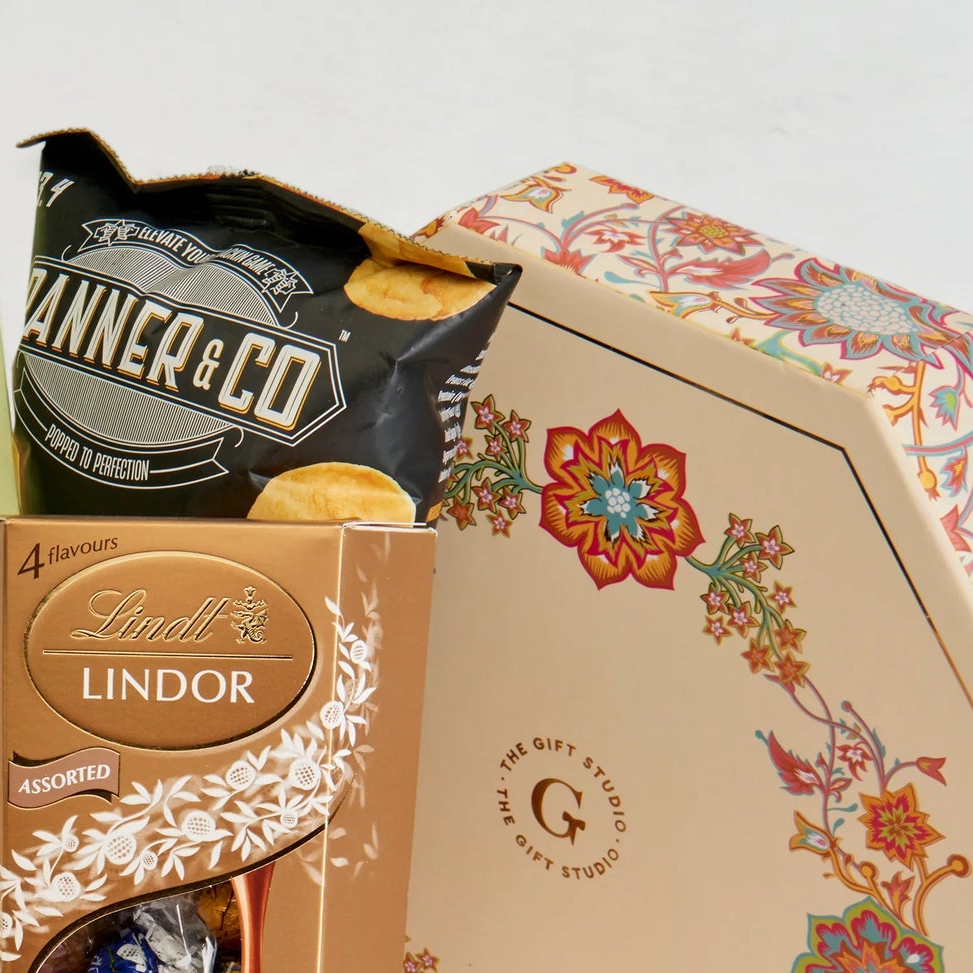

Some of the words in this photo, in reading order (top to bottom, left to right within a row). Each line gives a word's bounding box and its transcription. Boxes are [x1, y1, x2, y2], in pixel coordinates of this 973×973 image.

[138, 227, 187, 252] ELEVATE
[193, 338, 224, 390] &
[218, 331, 322, 431] CO
[45, 423, 80, 462] POPPED
[79, 446, 93, 469] TO
[93, 452, 150, 481] PERFECTION
[17, 542, 45, 580] 4
[47, 536, 120, 565] flavours
[69, 588, 231, 643] Lindt
[82, 667, 256, 704] LINDOR
[18, 763, 111, 795] ASSORTED
[499, 742, 528, 772] THE
[532, 736, 577, 757] GIFT
[582, 756, 627, 832] STUDIO
[497, 788, 515, 826] THE
[515, 834, 554, 870] GIFT
[561, 848, 619, 880] STUDIO
[530, 777, 586, 847] G
